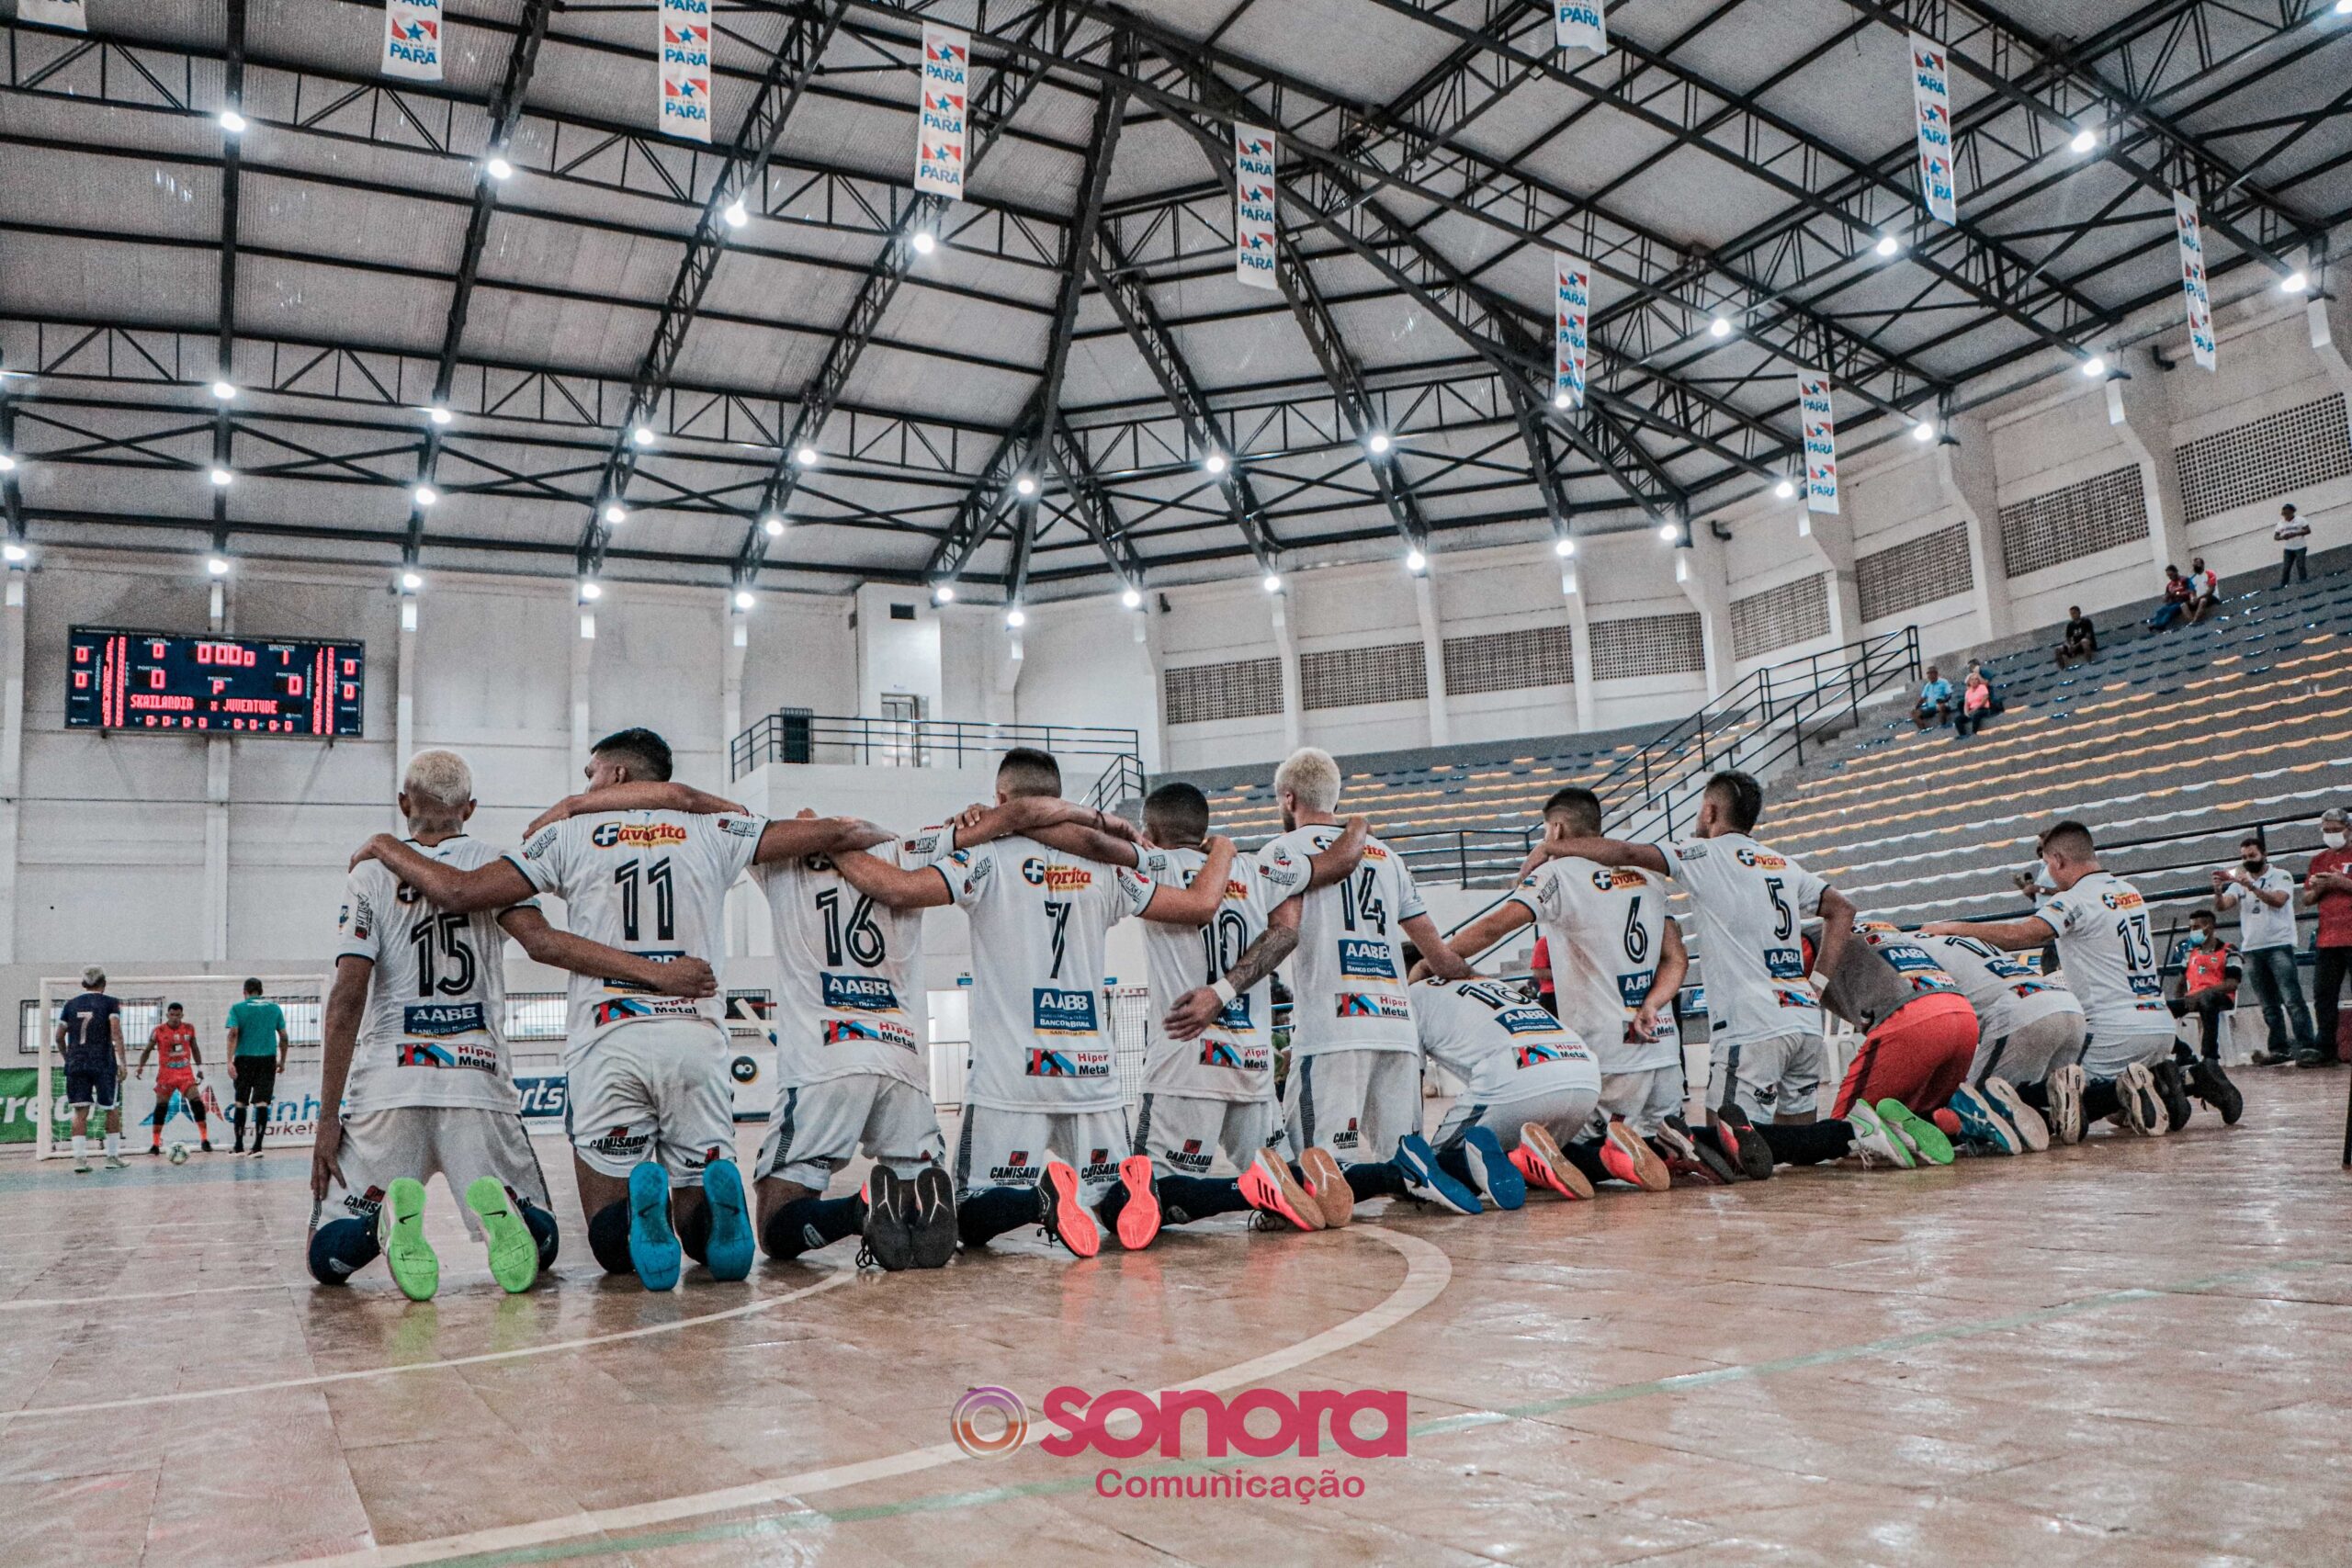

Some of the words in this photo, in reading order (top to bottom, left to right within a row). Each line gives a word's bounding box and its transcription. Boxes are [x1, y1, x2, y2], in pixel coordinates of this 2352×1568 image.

[222, 698, 278, 715] JUVENTUDE
[614, 856, 674, 941] 11
[1340, 867, 1385, 936] 14
[1765, 877, 1792, 941] 5
[816, 887, 886, 967] 16
[1623, 896, 1648, 964] 6
[1044, 900, 1071, 978] 7
[2117, 914, 2152, 971] 13
[411, 912, 475, 997] 15
[829, 977, 889, 996] AABB
[412, 1006, 478, 1022] AABB
[654, 1007, 697, 1015] Metal
[1381, 1007, 1408, 1018] Metal
[1504, 1010, 1549, 1023] AABB
[77, 1012, 94, 1044] 7
[881, 1032, 917, 1050] Metal
[458, 1055, 496, 1072] Metal
[1077, 1053, 1109, 1063] Hiper
[1079, 1065, 1109, 1076] Metal
